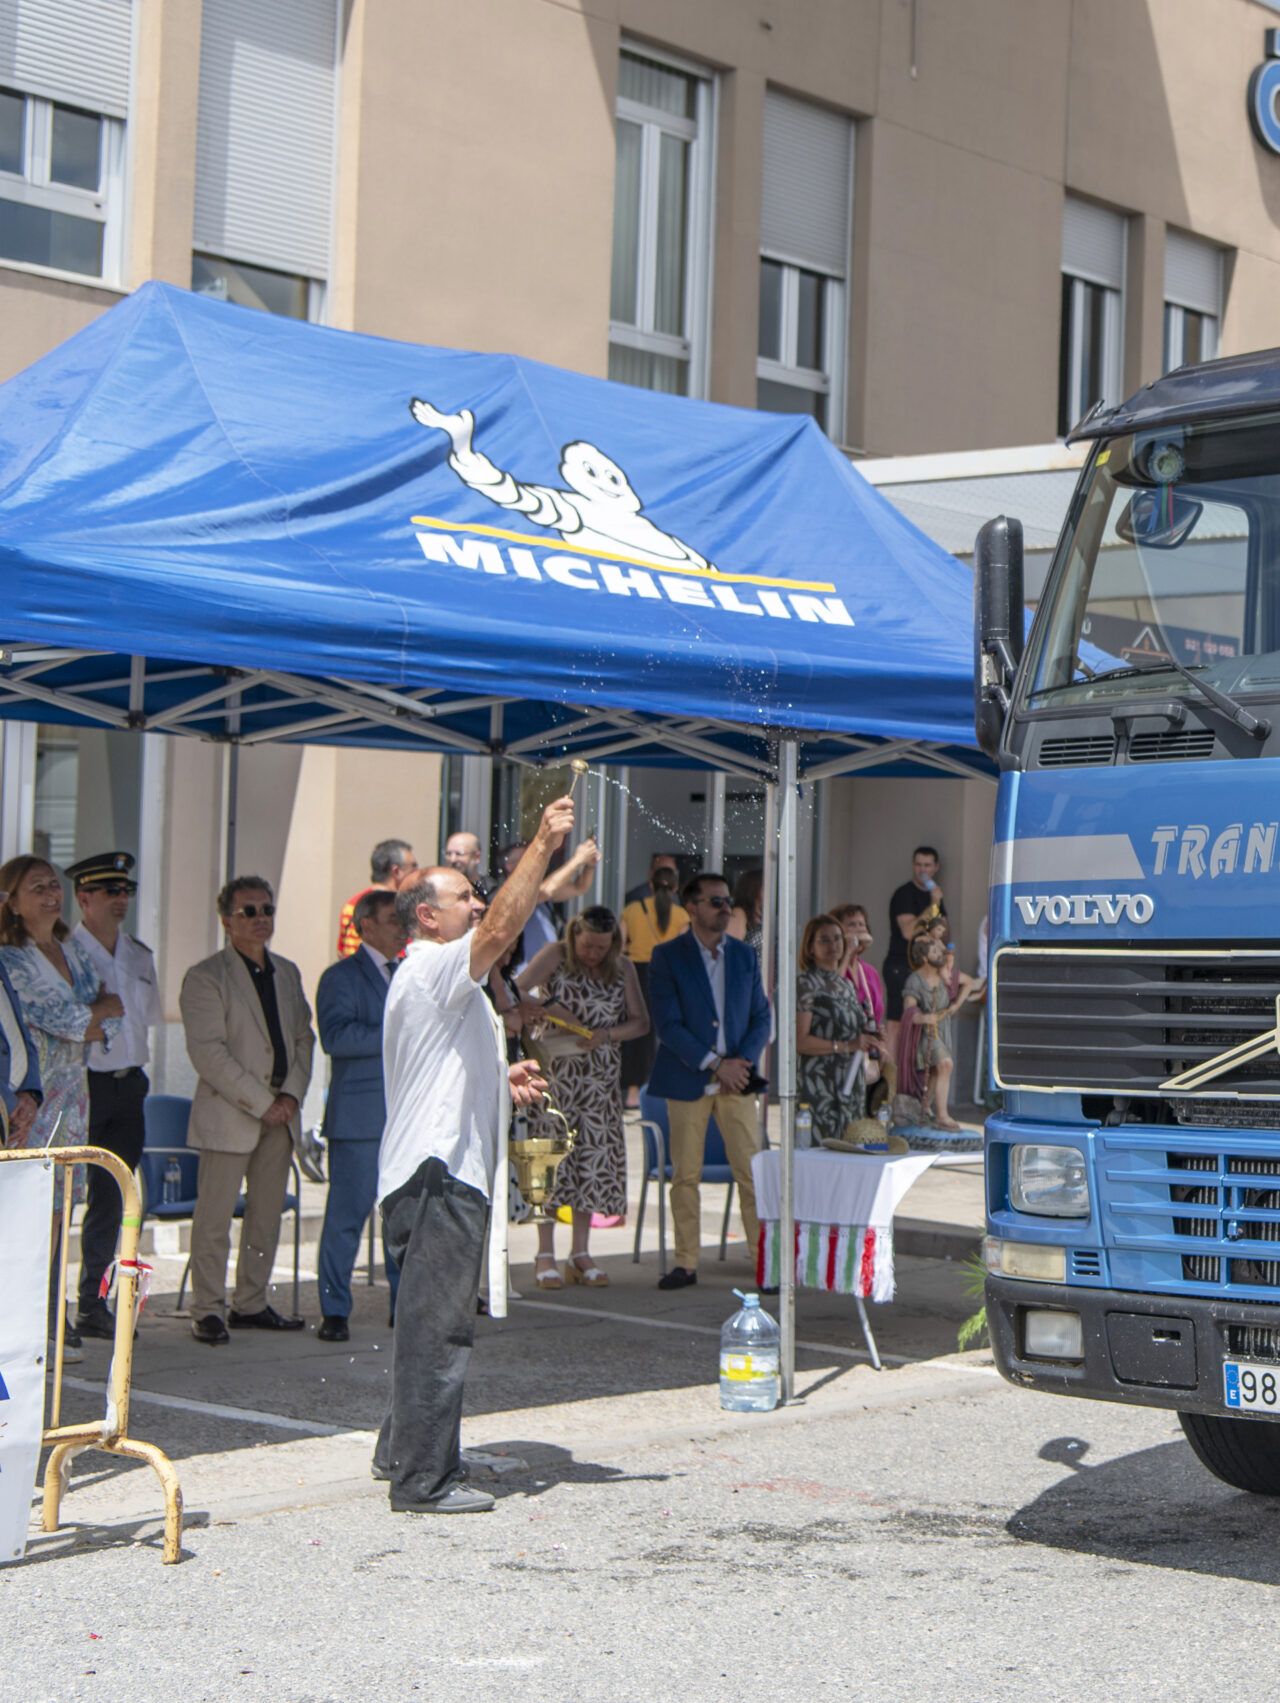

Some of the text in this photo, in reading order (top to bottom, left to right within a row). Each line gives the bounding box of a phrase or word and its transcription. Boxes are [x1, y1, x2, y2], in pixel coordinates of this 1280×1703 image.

[415, 531, 855, 627] MICHELIN
[1014, 893, 1154, 925] VOLVO
[1230, 1389, 1237, 1400] E
